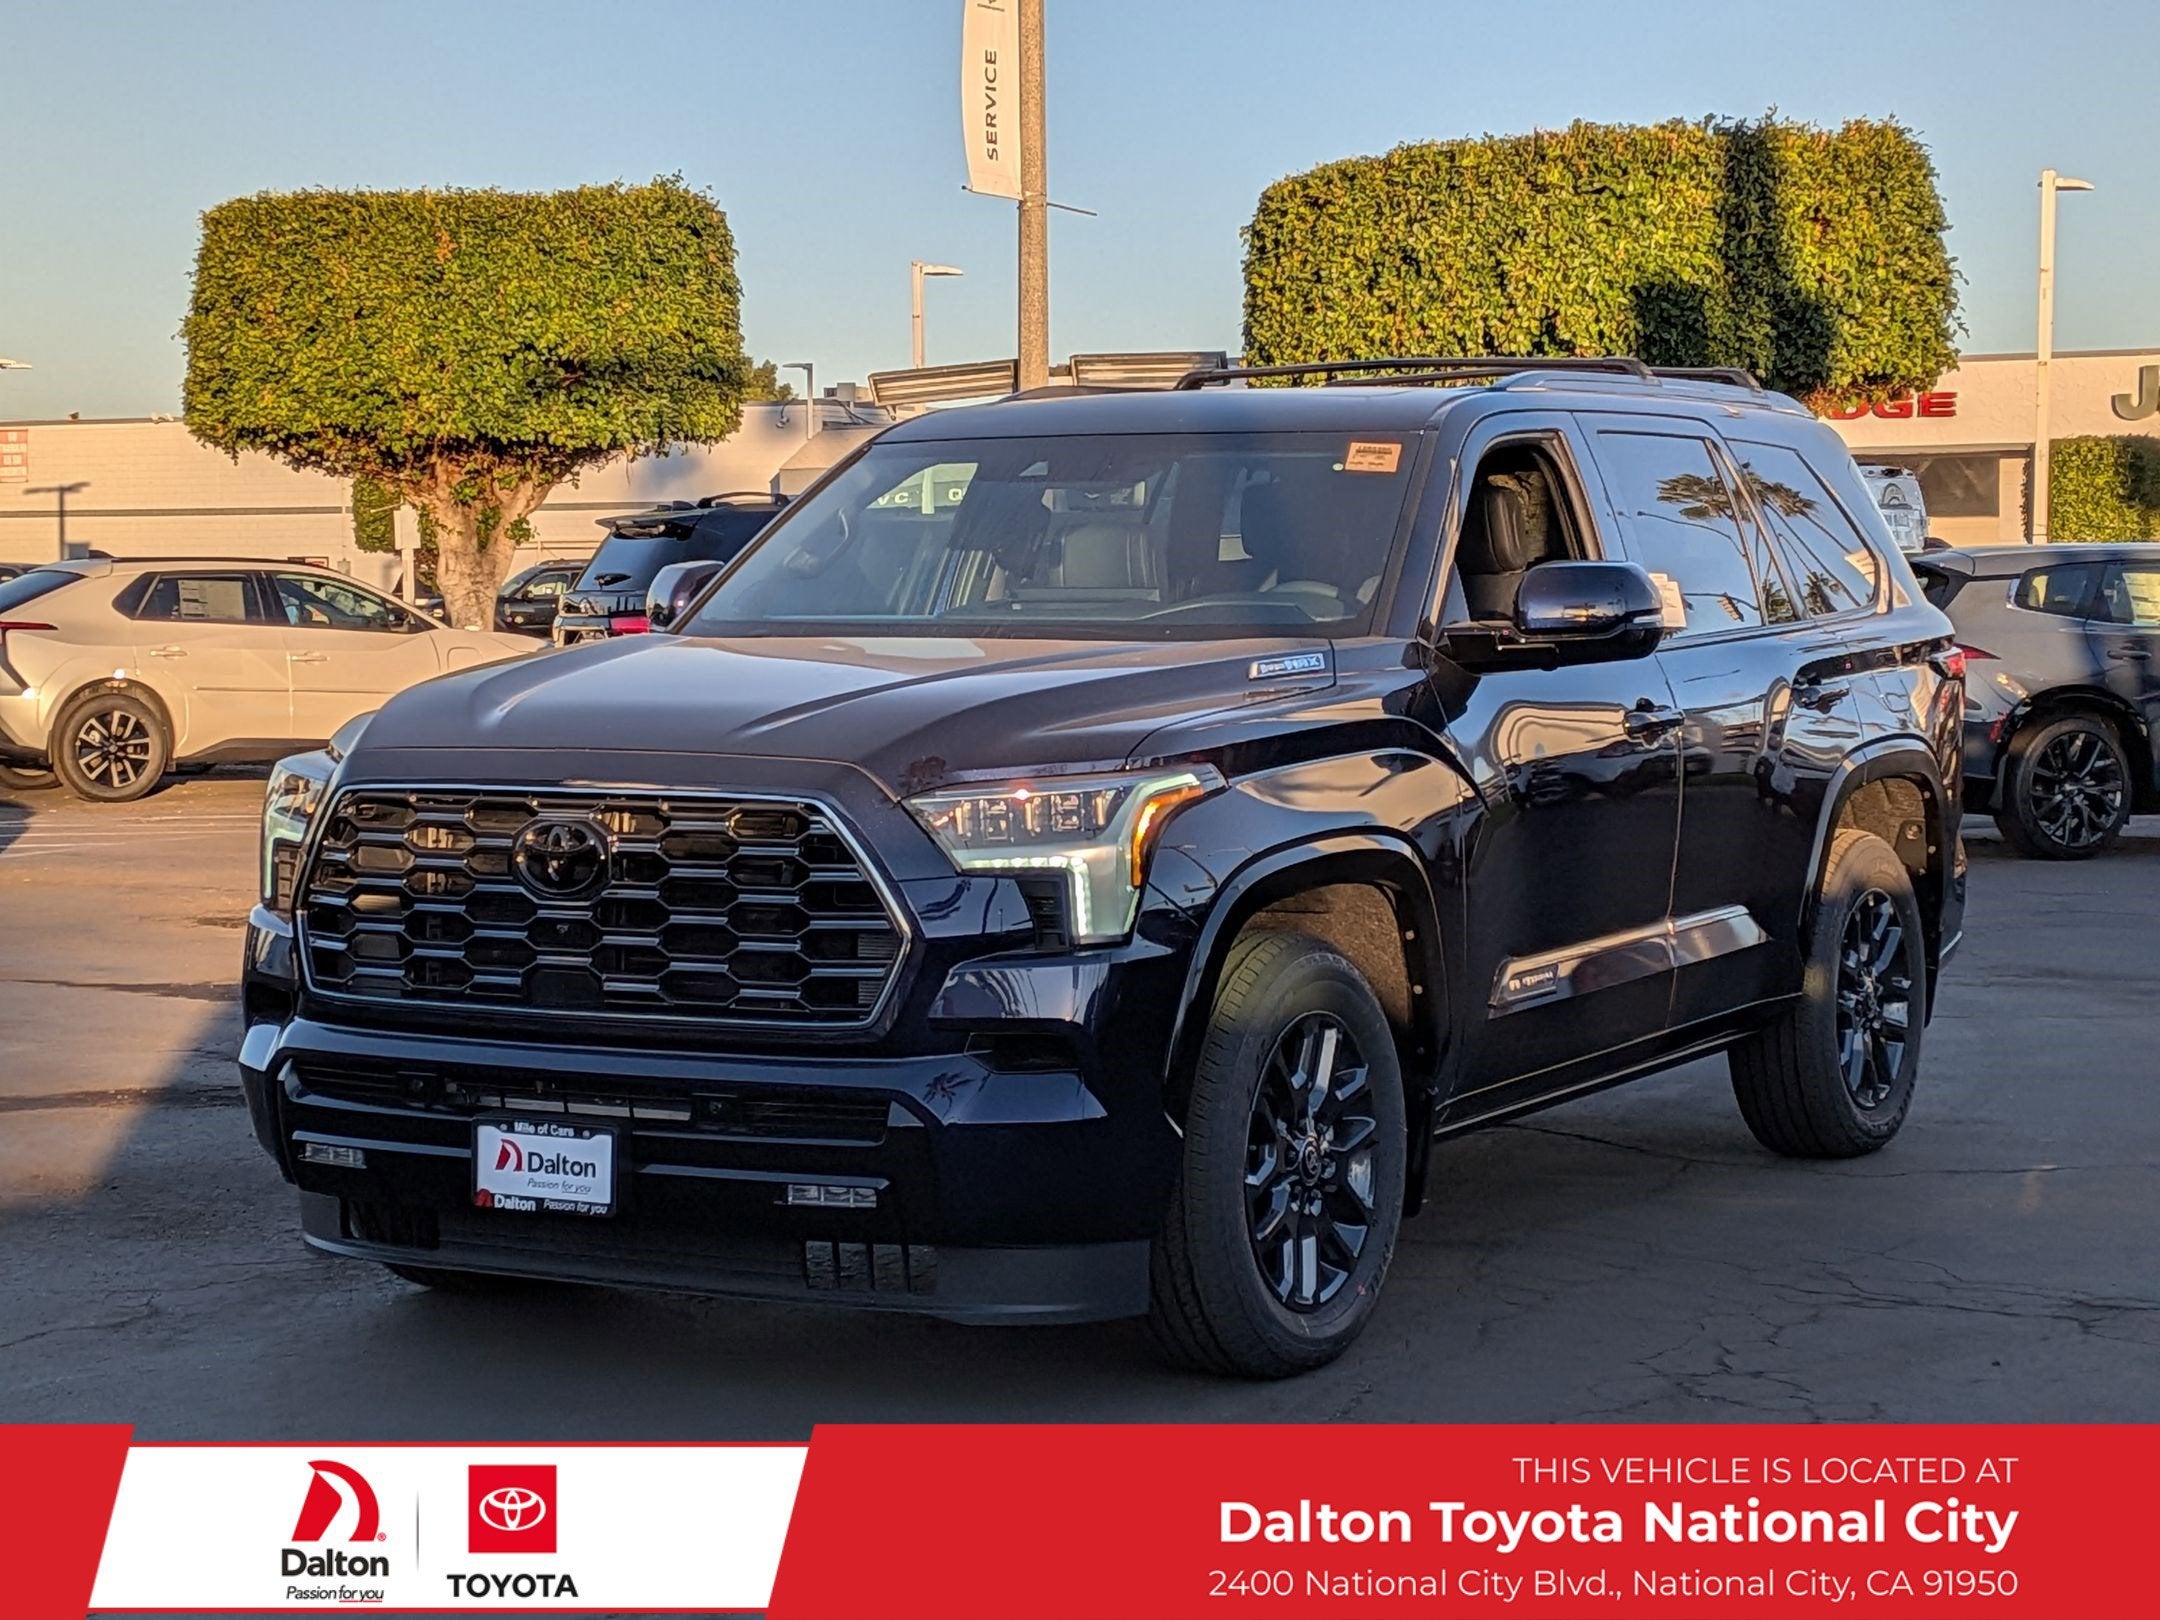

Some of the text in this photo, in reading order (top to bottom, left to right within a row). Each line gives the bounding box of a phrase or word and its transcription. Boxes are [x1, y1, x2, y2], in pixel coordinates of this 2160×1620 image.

[984, 49, 999, 161] SERVICE
[2111, 365, 2160, 421] J
[514, 1121, 575, 1137] Mile of Cars
[527, 1151, 596, 1178] Dalton
[527, 1178, 592, 1194] Passion for you
[494, 1194, 536, 1211] Dalton
[543, 1199, 608, 1215] Passion for you
